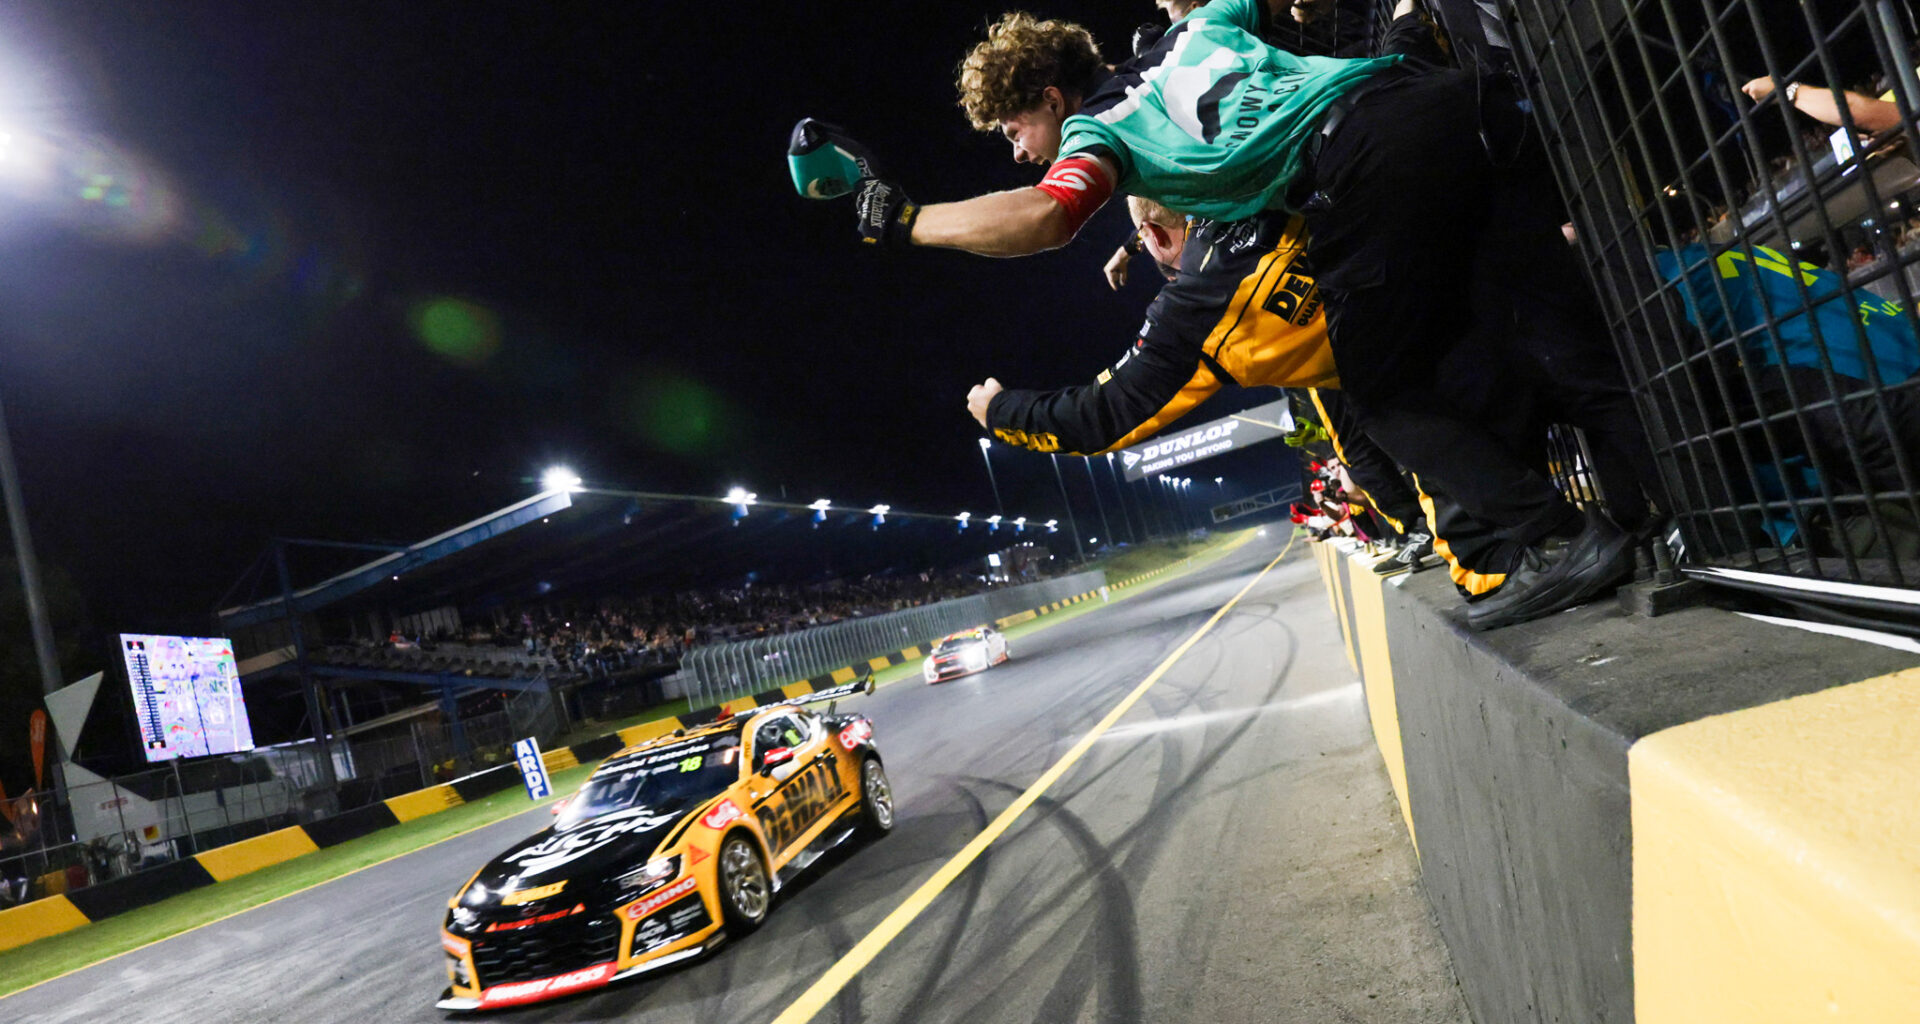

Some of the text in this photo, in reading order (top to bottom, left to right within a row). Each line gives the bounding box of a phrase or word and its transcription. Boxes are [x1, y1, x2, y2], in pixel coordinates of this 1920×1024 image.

[1141, 439, 1232, 474] TAKING YOU BEYOND
[1143, 420, 1239, 461] DUNLOP
[680, 755, 703, 774] 18
